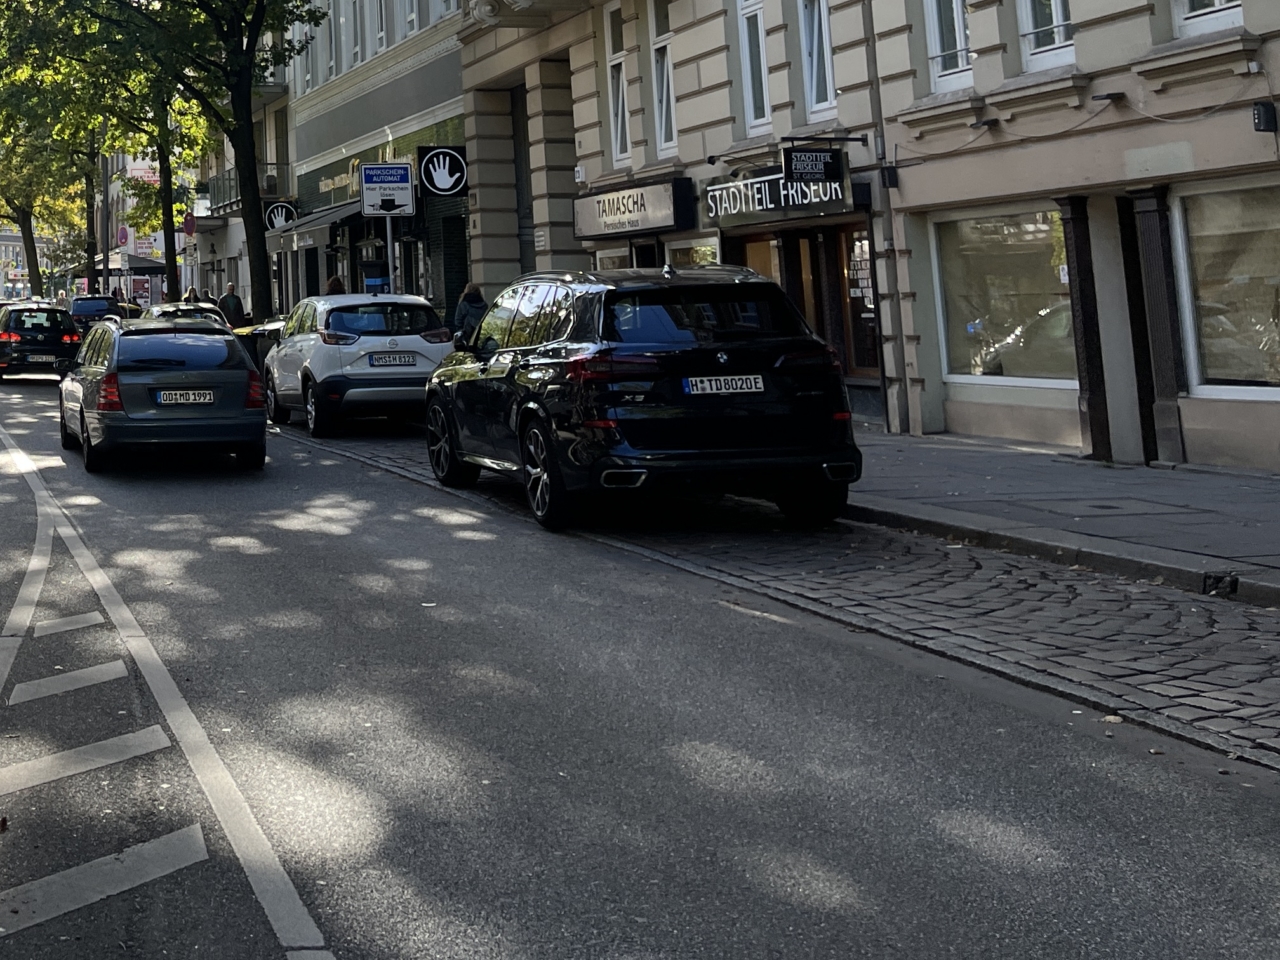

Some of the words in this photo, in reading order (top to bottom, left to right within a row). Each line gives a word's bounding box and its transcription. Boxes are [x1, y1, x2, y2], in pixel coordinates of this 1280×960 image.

[792, 153, 832, 162] STADTTEIL
[792, 162, 824, 171] FRISEUR
[707, 178, 775, 218] STADTTEIL
[779, 179, 843, 207] FRISEUR
[596, 192, 647, 218] TAMASCHA
[603, 219, 627, 231] Persisches
[191, 392, 213, 401] 1991
